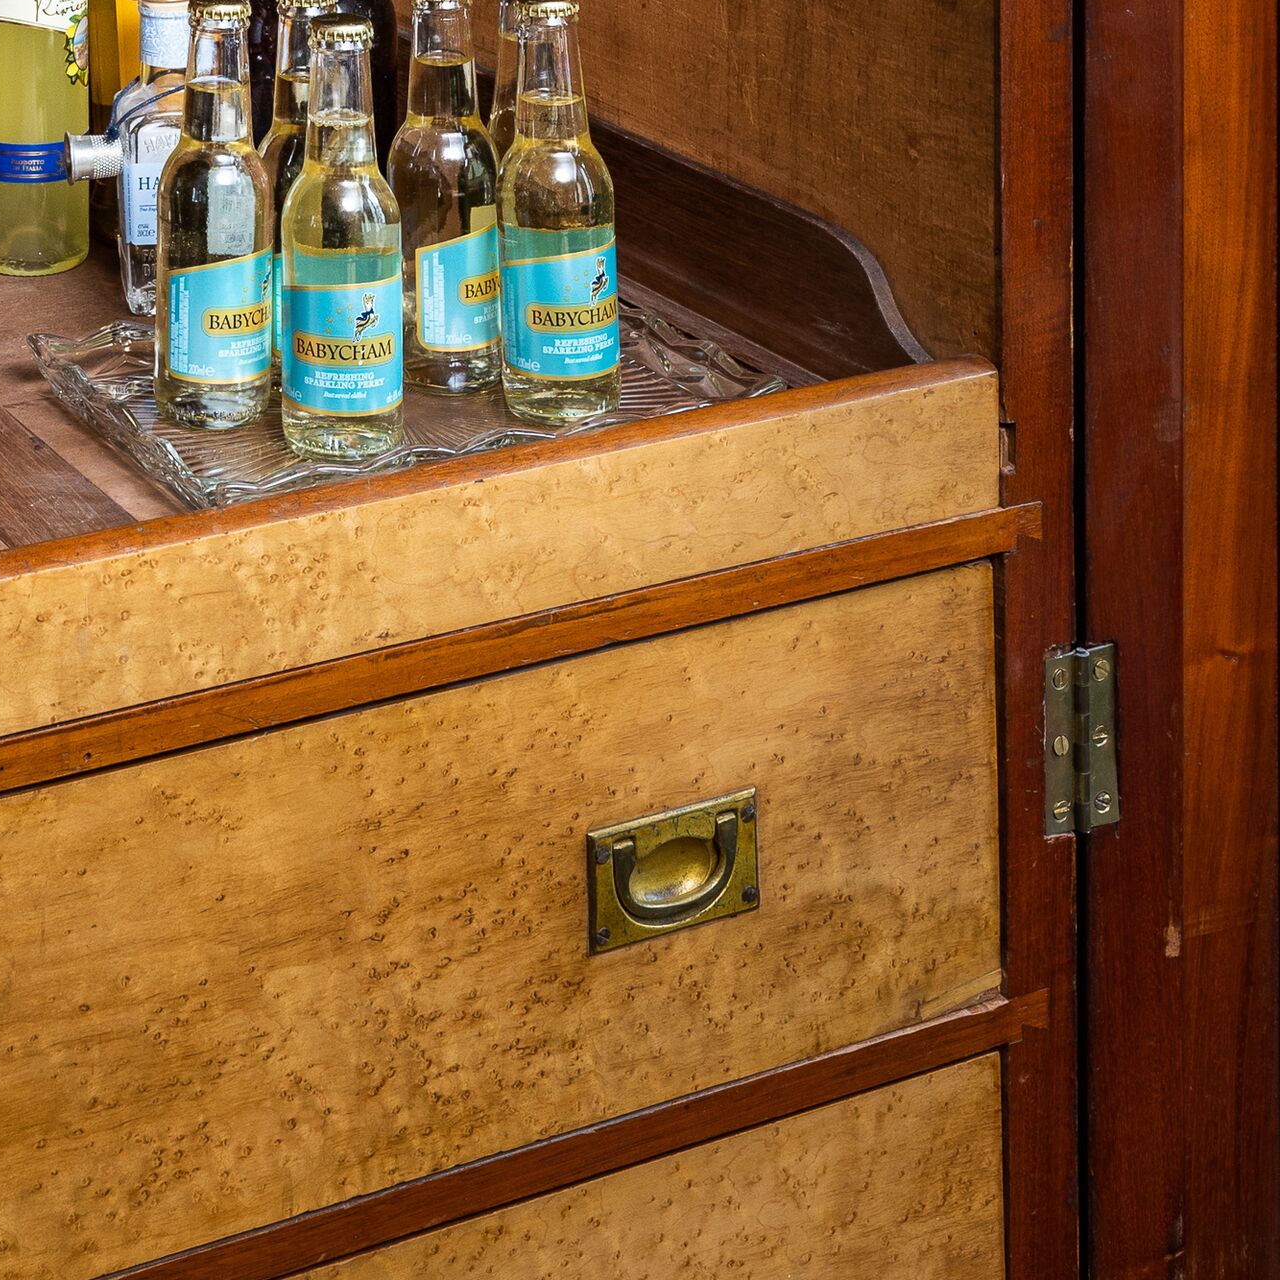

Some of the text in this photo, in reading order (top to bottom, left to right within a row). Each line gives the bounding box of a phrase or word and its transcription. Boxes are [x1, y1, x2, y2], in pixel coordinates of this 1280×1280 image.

[531, 299, 617, 327] BABYCHAM
[554, 333, 608, 347] REFRESHING
[296, 337, 392, 361] BABYCHAM
[543, 344, 594, 355] SPARKLING
[314, 370, 375, 381] REFRESHING
[304, 376, 385, 389] SPARKLING PERRY
